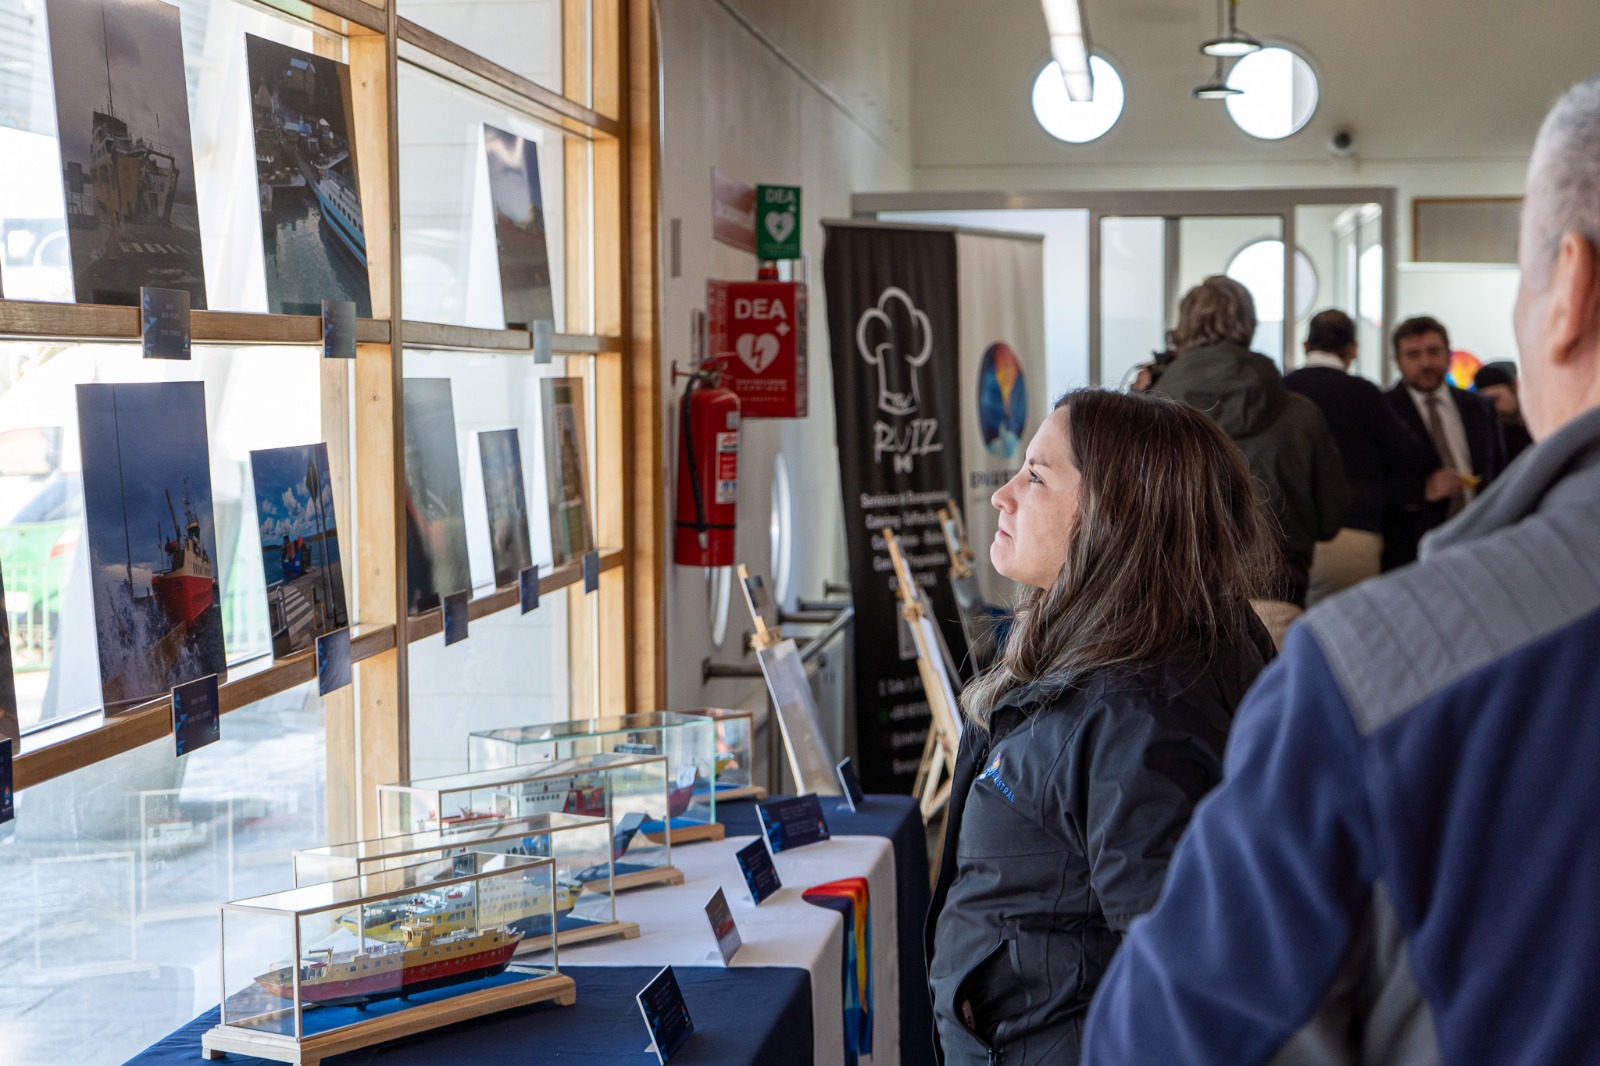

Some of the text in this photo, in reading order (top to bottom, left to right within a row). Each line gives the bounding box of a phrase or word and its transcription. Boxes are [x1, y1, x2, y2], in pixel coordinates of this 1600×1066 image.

[765, 188, 797, 204] DEA
[734, 298, 788, 320] DEA
[873, 418, 944, 464] RUIZ
